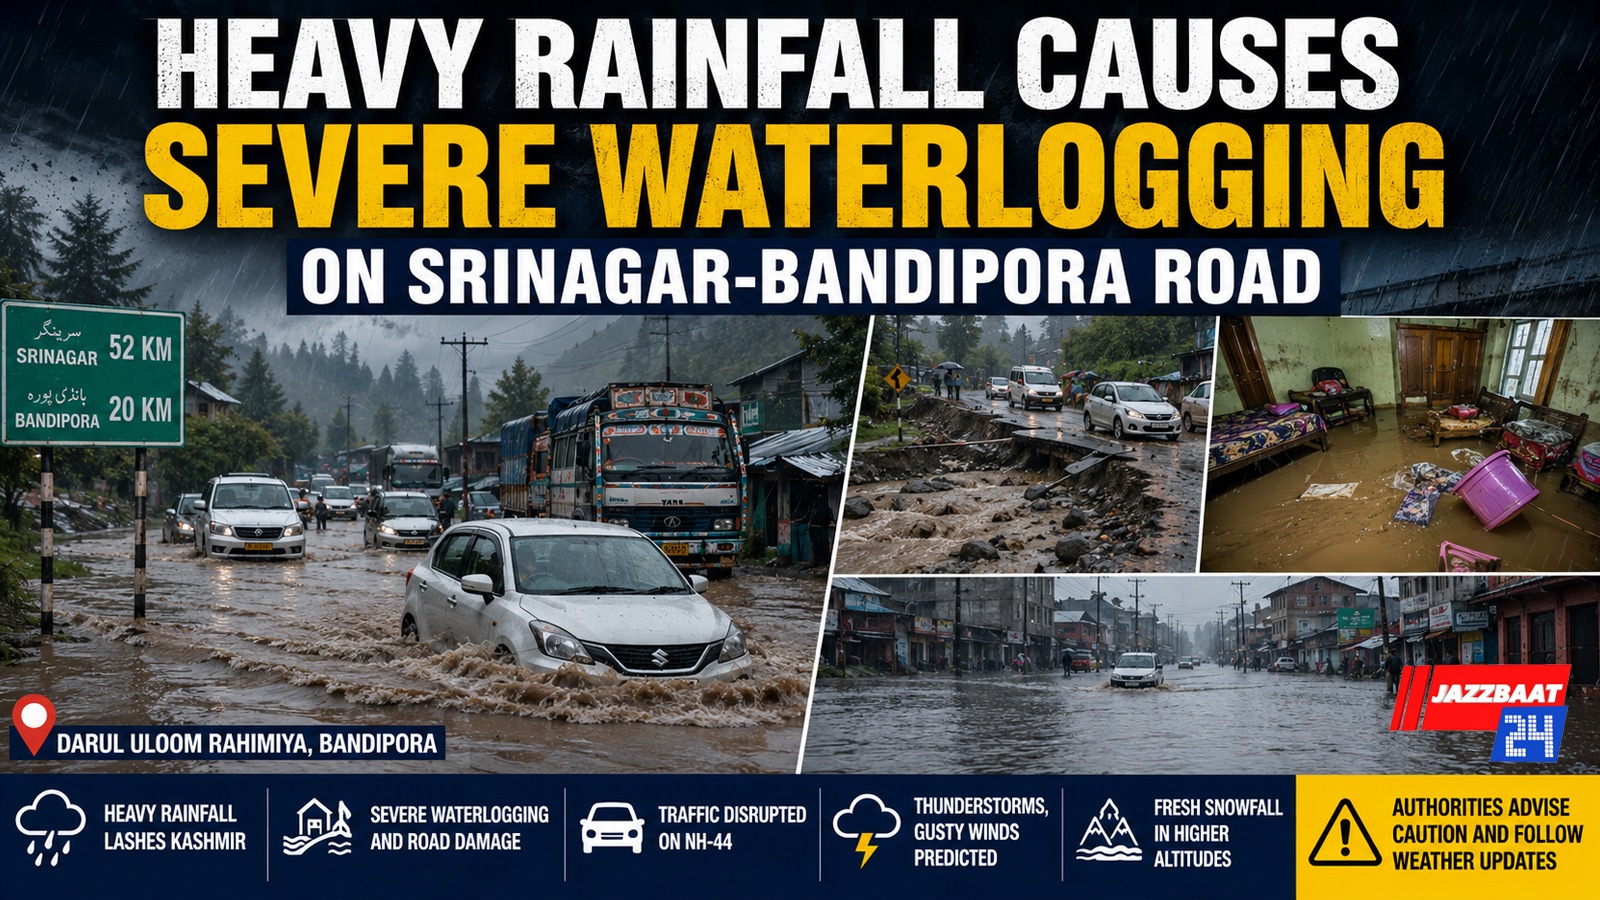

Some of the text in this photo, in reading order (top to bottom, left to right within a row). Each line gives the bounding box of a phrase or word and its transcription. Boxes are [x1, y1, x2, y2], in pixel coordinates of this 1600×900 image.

[16, 347, 98, 366] SRINAGAR
[109, 334, 172, 362] 52 KM
[109, 395, 172, 422] 20 KM
[15, 412, 100, 429] BANDIPORA
